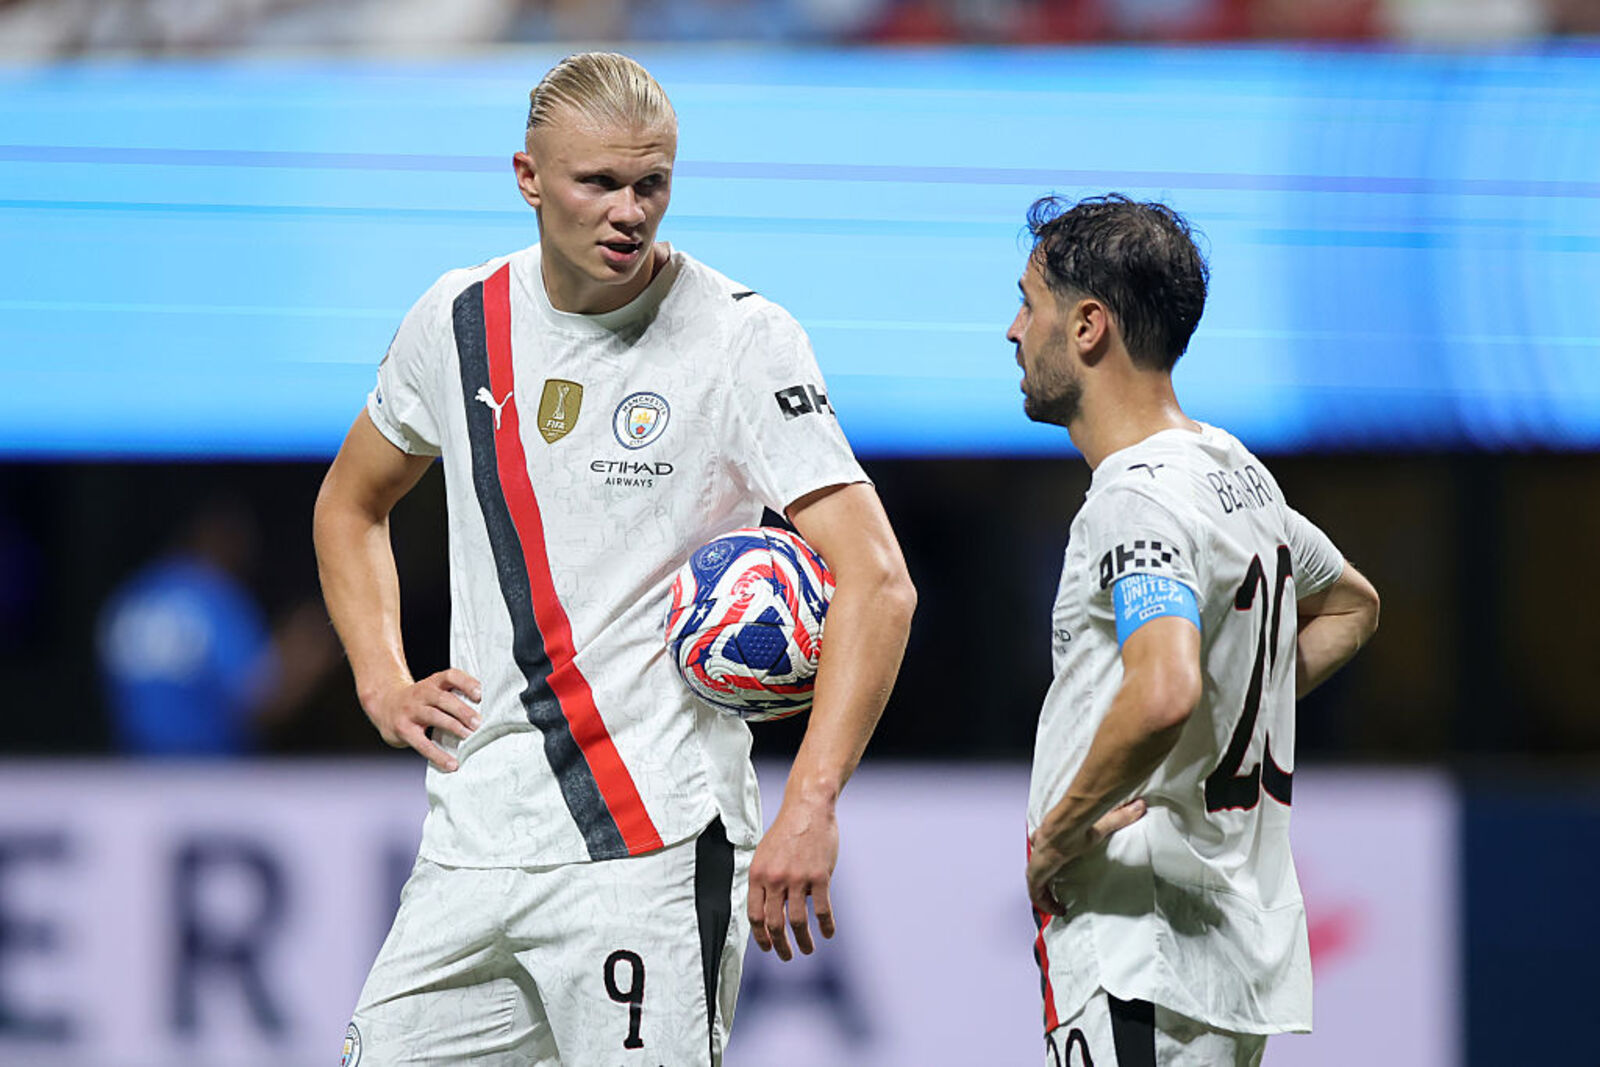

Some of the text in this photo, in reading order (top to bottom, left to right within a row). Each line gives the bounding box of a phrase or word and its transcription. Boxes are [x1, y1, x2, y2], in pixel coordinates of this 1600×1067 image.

[622, 396, 667, 416] MANCHESTER
[546, 419, 565, 430] FIFA
[590, 460, 674, 476] ETIHAD
[605, 477, 653, 488] AIRWAYS
[1122, 579, 1180, 606] UNITES
[603, 949, 645, 1050] 9
